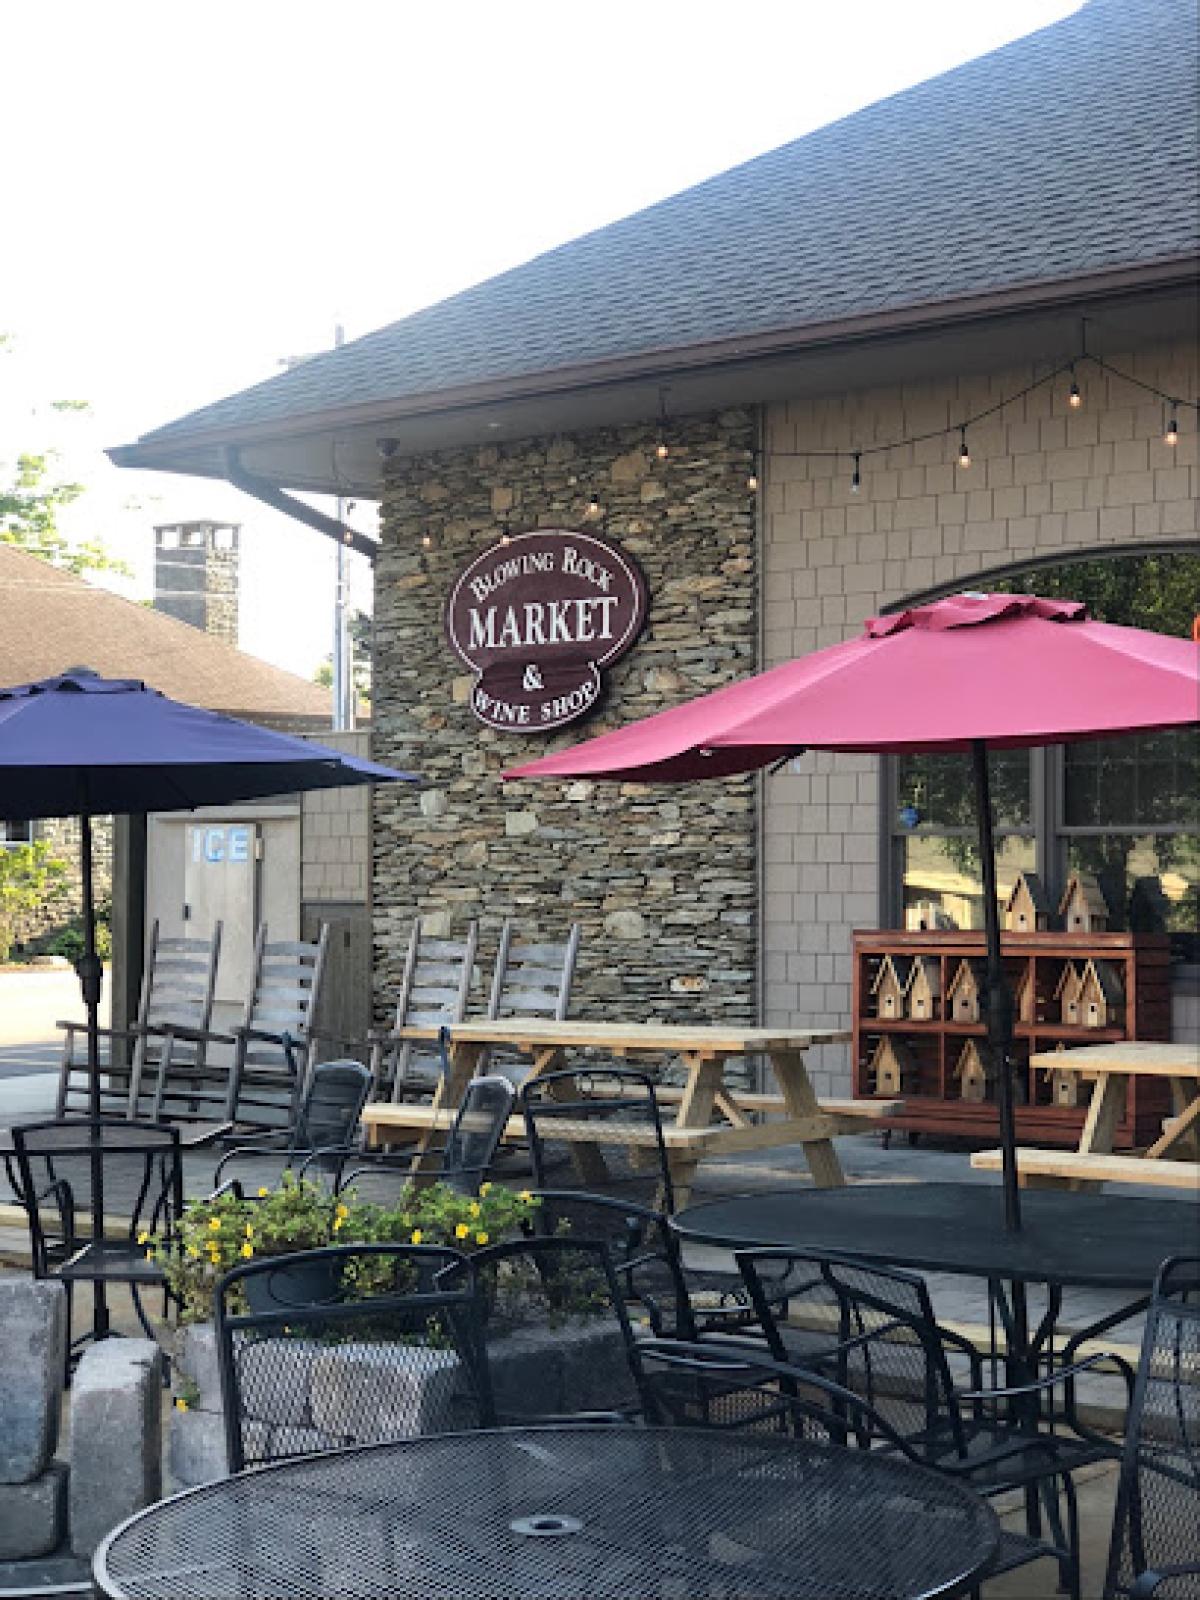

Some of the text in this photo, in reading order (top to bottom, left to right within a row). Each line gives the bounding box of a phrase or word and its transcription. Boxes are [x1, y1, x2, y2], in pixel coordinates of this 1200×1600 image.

[468, 546, 615, 603] BLOWING ROCK
[467, 596, 619, 650] MARKET
[522, 663, 545, 691] &
[474, 681, 596, 724] WINE SHOP
[191, 825, 249, 863] ICE
